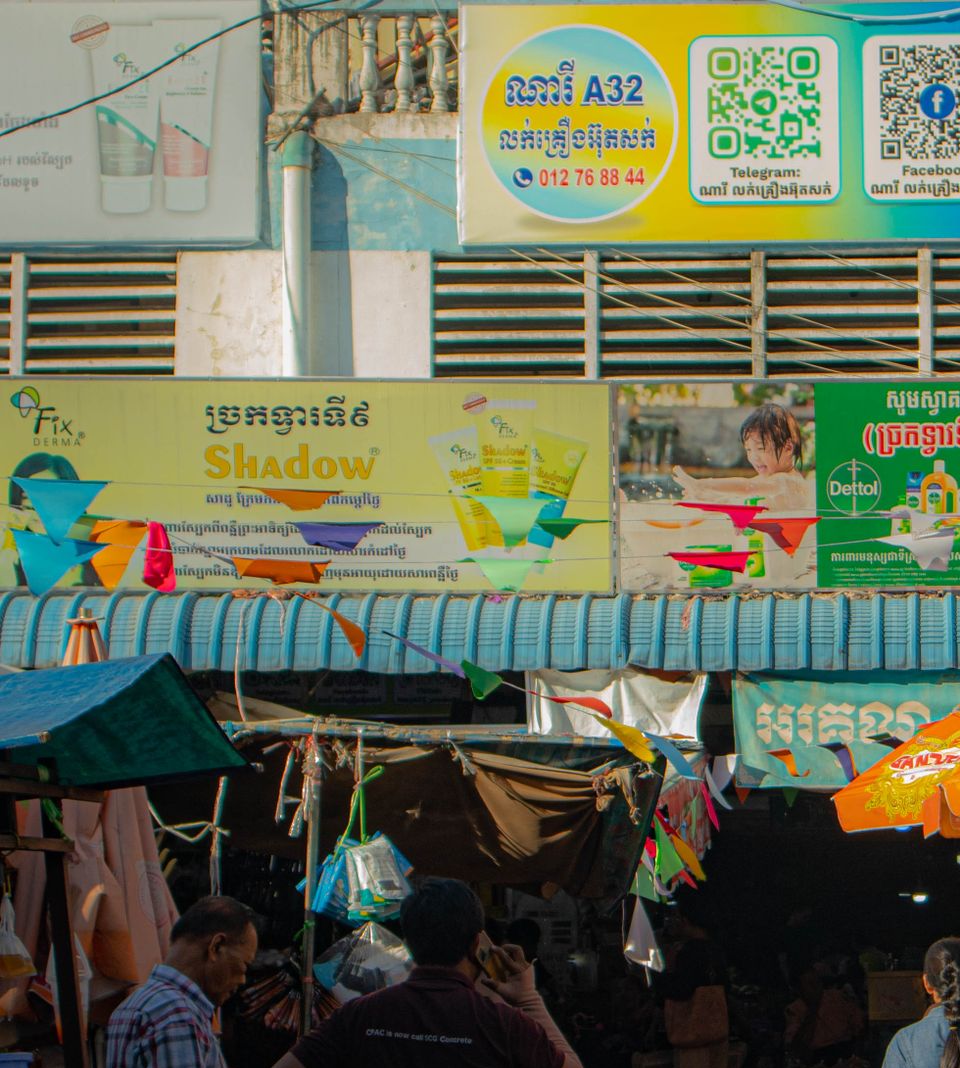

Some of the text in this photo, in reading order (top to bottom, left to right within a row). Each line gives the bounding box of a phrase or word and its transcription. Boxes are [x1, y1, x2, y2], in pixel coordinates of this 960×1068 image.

[582, 73, 644, 106] A32
[539, 167, 645, 187] 012 76 88 44
[730, 167, 801, 181] Telegram:
[829, 480, 878, 497] Dettol
